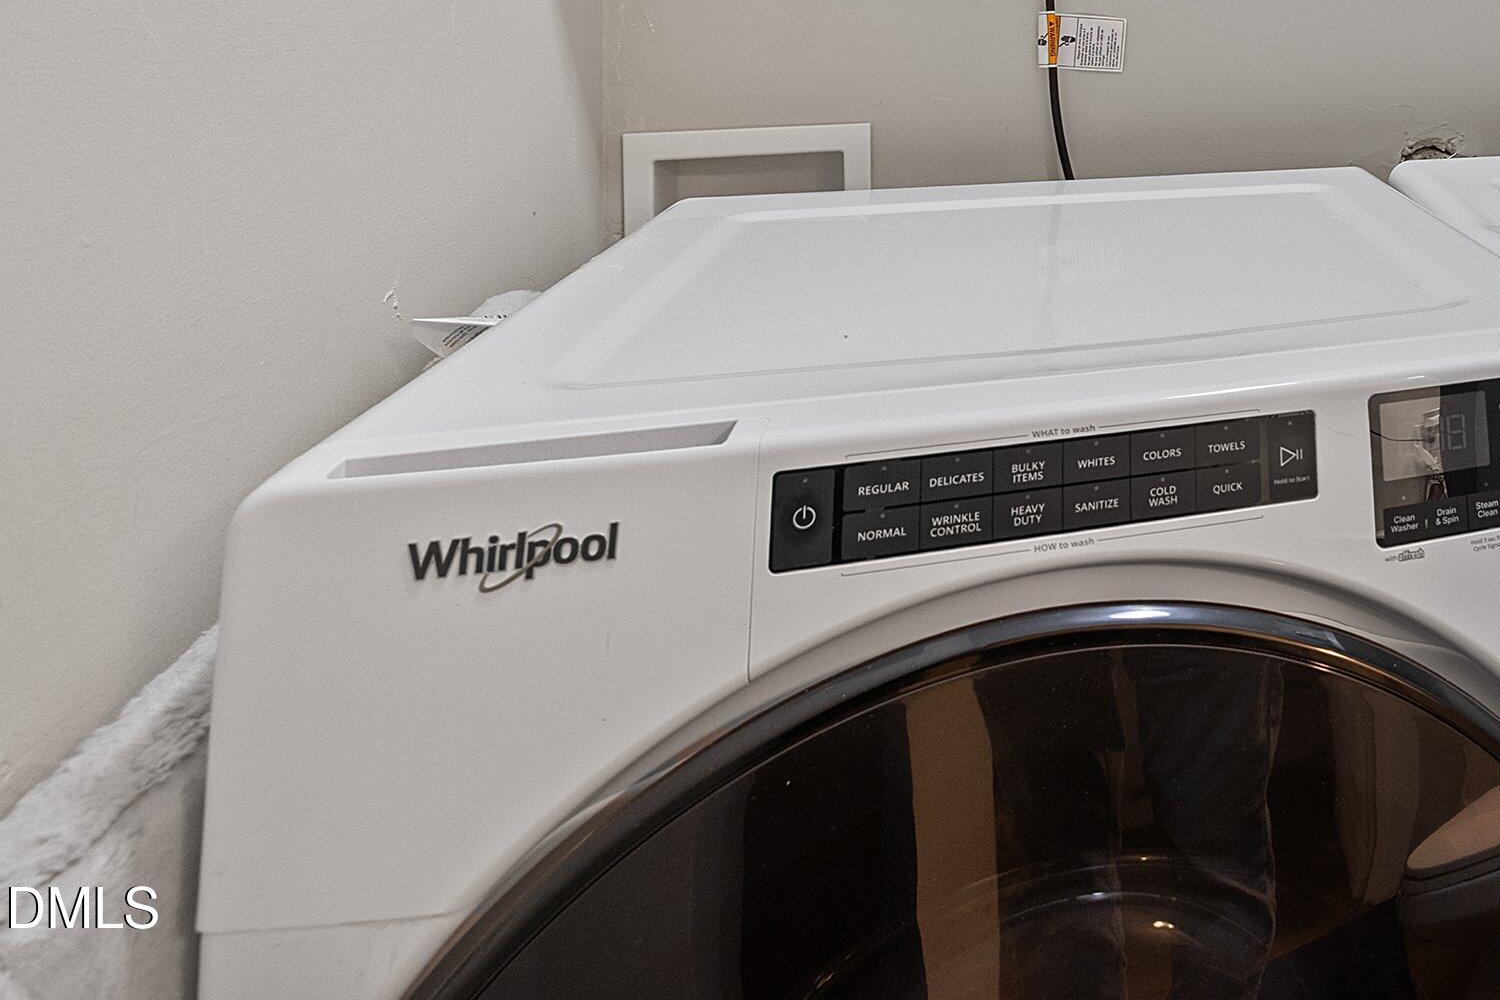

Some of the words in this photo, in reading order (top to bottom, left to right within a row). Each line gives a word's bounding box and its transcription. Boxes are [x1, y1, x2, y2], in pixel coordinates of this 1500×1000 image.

[1031, 428, 1060, 438] WHAT
[1061, 427, 1071, 435] to
[1072, 424, 1096, 435] wash
[1208, 440, 1246, 453] TOWELS
[1143, 448, 1182, 461] COLORS
[1011, 460, 1046, 473] BULKY
[1077, 456, 1115, 469] WHITES
[929, 472, 985, 487] DELICATES
[1012, 471, 1044, 484] ITEMS
[858, 481, 910, 496] REGULAR
[1150, 485, 1177, 498] COLD
[1212, 481, 1243, 495] QUICK
[1075, 498, 1119, 513] SANITIZE
[1148, 495, 1178, 508] WASH
[1475, 498, 1499, 510] Steam
[1010, 503, 1046, 516] HEAVY
[1436, 506, 1457, 517] Drain
[1477, 507, 1499, 519] Clean
[931, 511, 980, 526] WRINKLE
[1013, 514, 1043, 527] DUTY
[1393, 513, 1416, 524] Clean
[1442, 515, 1459, 525] Spin
[930, 523, 982, 538] CONTROL
[1390, 522, 1419, 533] Washer
[857, 527, 907, 542] NORMAL
[408, 522, 620, 581] Whirlpool
[1034, 542, 1057, 553] HOW
[1058, 541, 1069, 550] to
[1070, 537, 1095, 548] wash
